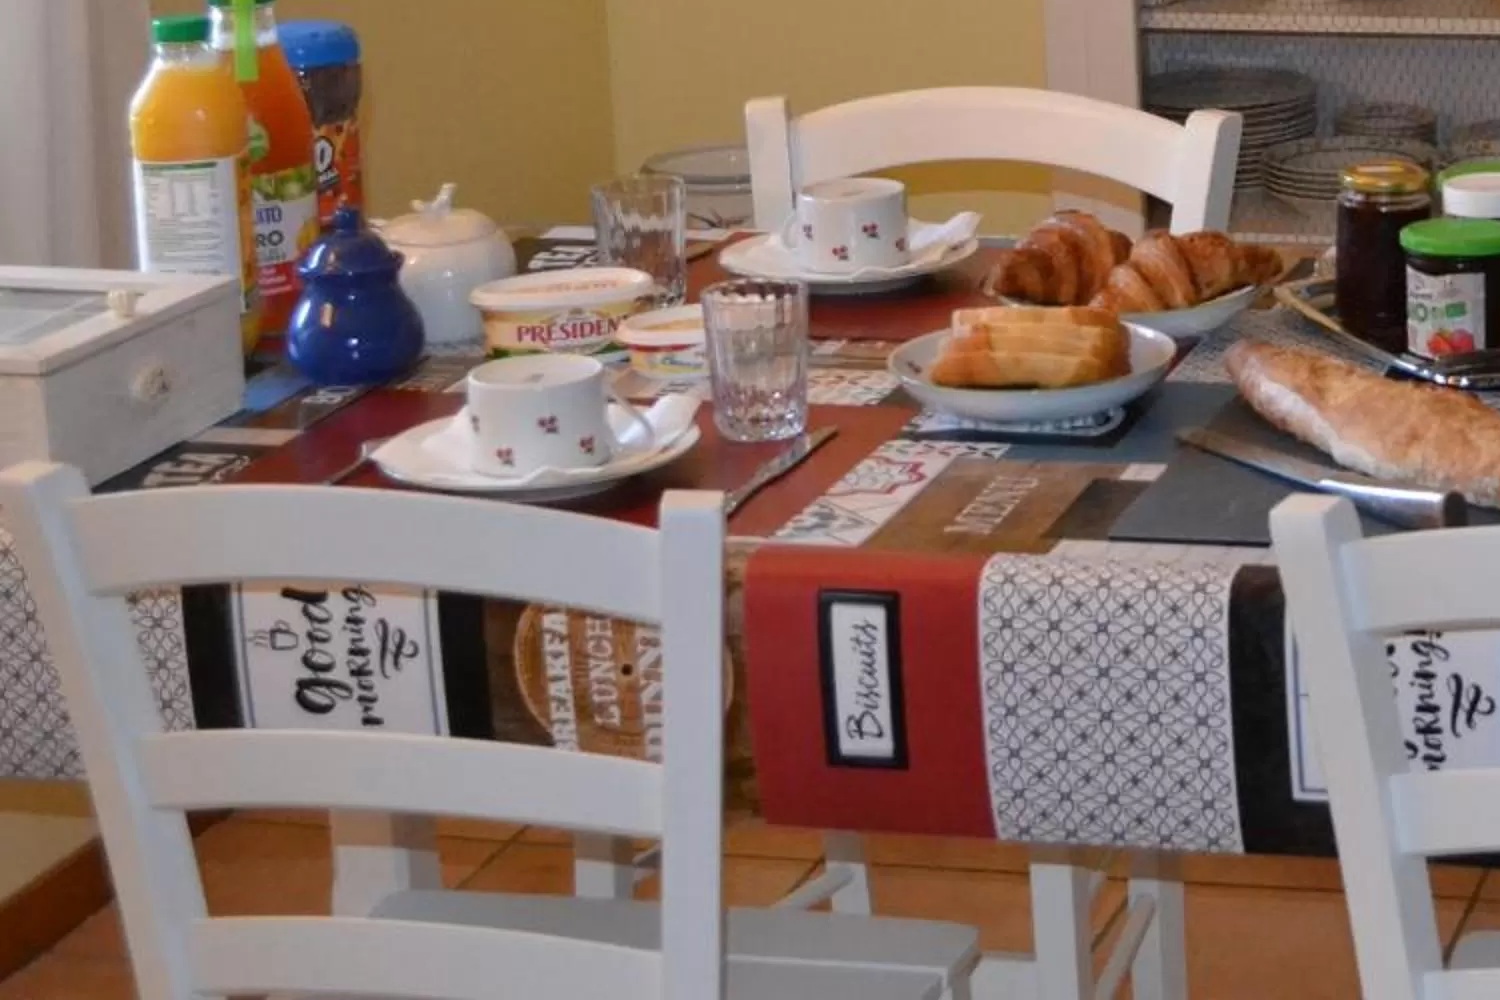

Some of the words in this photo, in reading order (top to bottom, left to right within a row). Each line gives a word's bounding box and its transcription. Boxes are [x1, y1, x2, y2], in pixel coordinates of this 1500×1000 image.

[944, 475, 1039, 534] MENU
[281, 587, 353, 714] good
[586, 616, 621, 727] LUNCH
[845, 618, 885, 740] Biscuits
